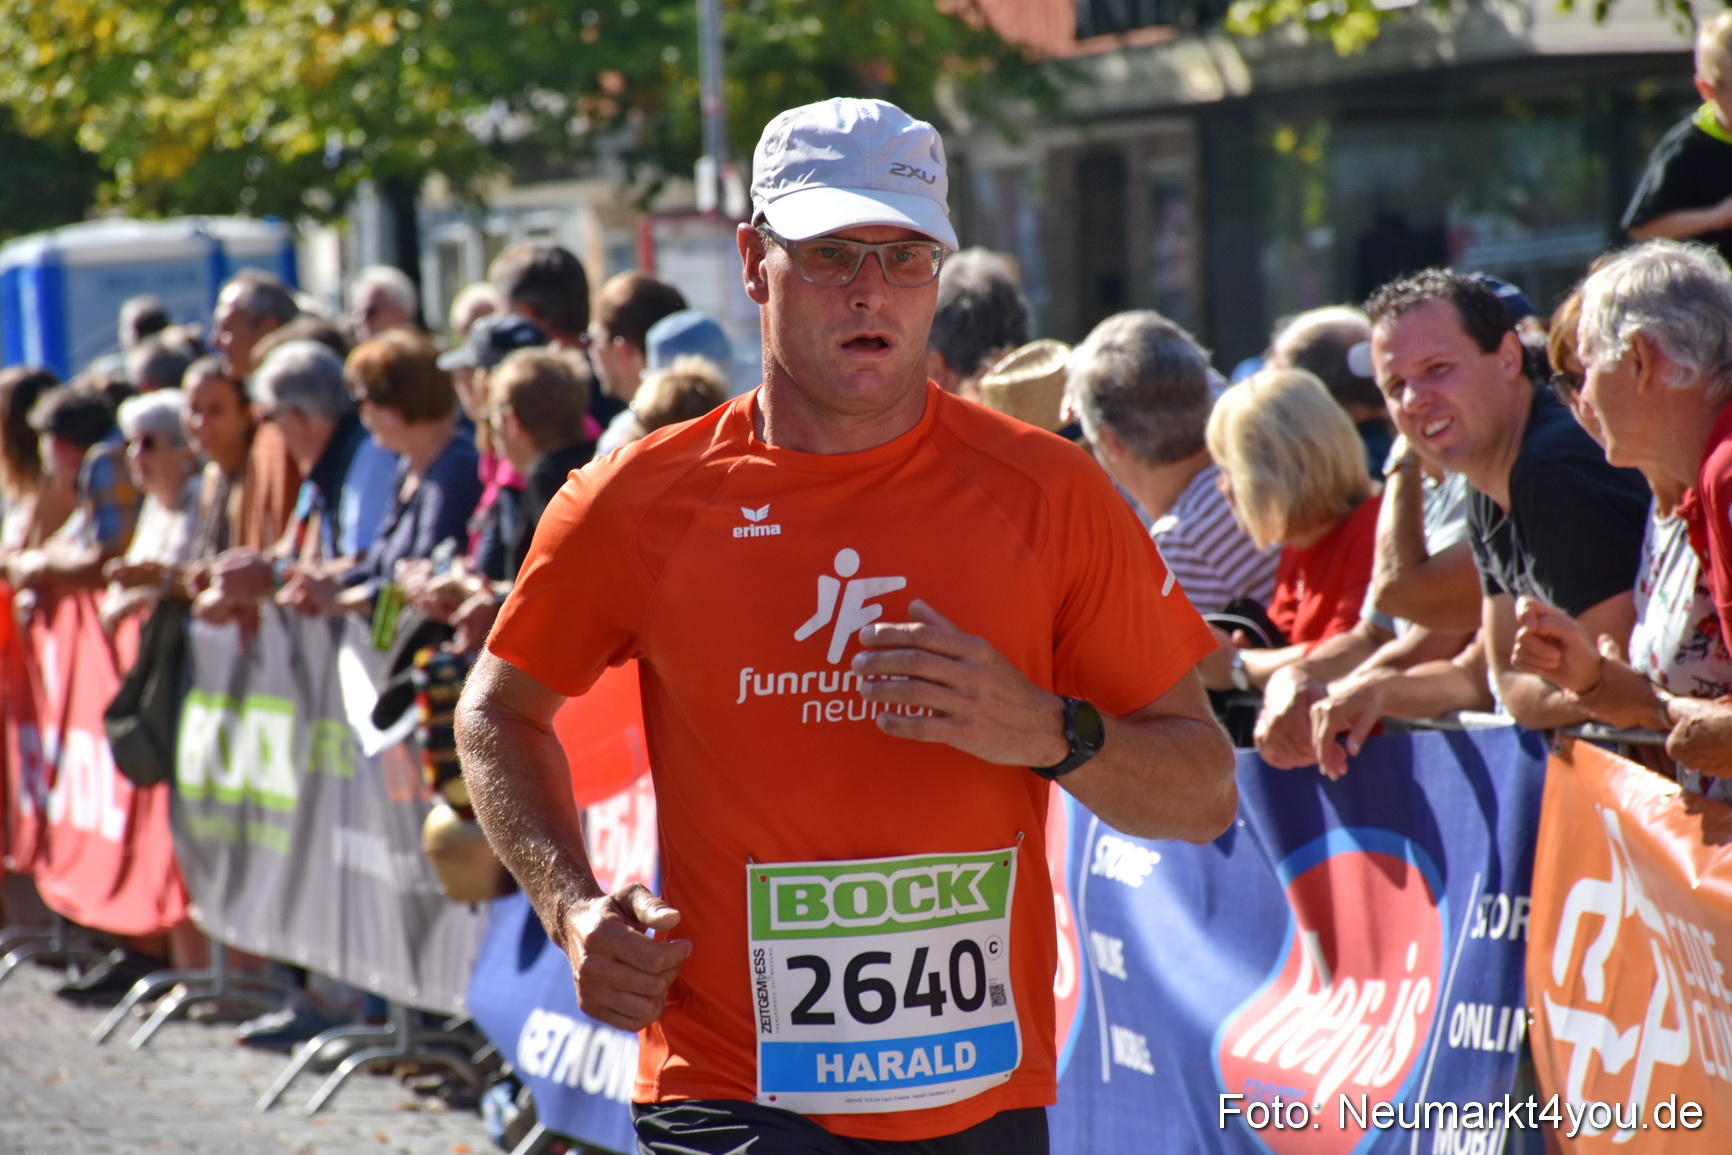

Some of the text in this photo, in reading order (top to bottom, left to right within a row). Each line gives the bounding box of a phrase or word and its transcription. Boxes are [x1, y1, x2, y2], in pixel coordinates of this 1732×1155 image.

[889, 162, 936, 185] 2XU
[732, 524, 781, 538] erima
[736, 667, 909, 704] funrun
[773, 866, 984, 926] BOCK
[988, 941, 998, 954] C
[786, 938, 986, 1026] 2640
[816, 1040, 978, 1083] HARALD
